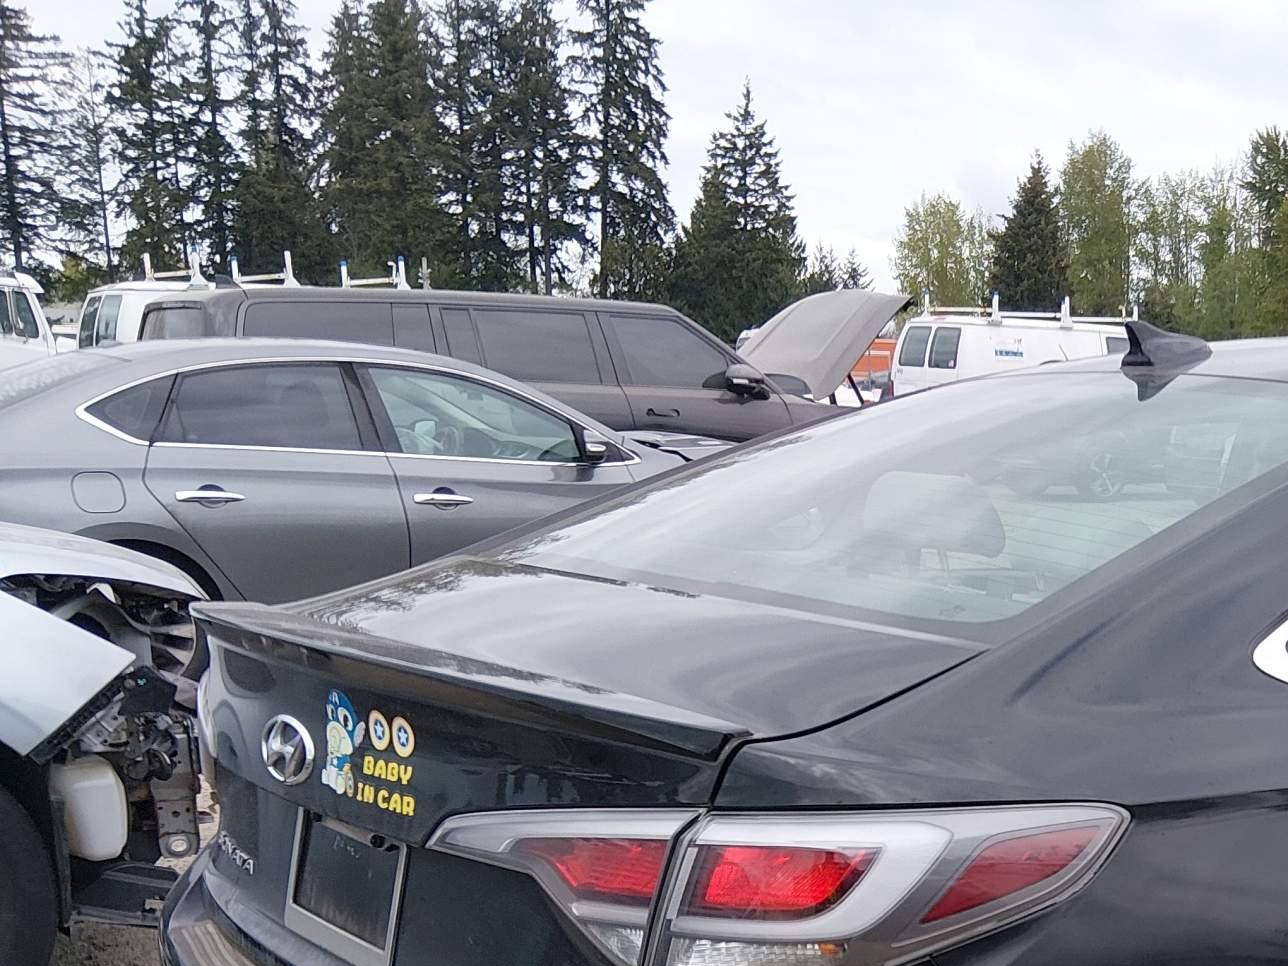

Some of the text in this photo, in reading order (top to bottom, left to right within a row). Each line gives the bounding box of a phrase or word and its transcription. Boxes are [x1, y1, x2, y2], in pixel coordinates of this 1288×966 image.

[363, 755, 413, 785] BABY
[356, 782, 415, 817] IN CAR
[218, 831, 255, 876] SONATA
